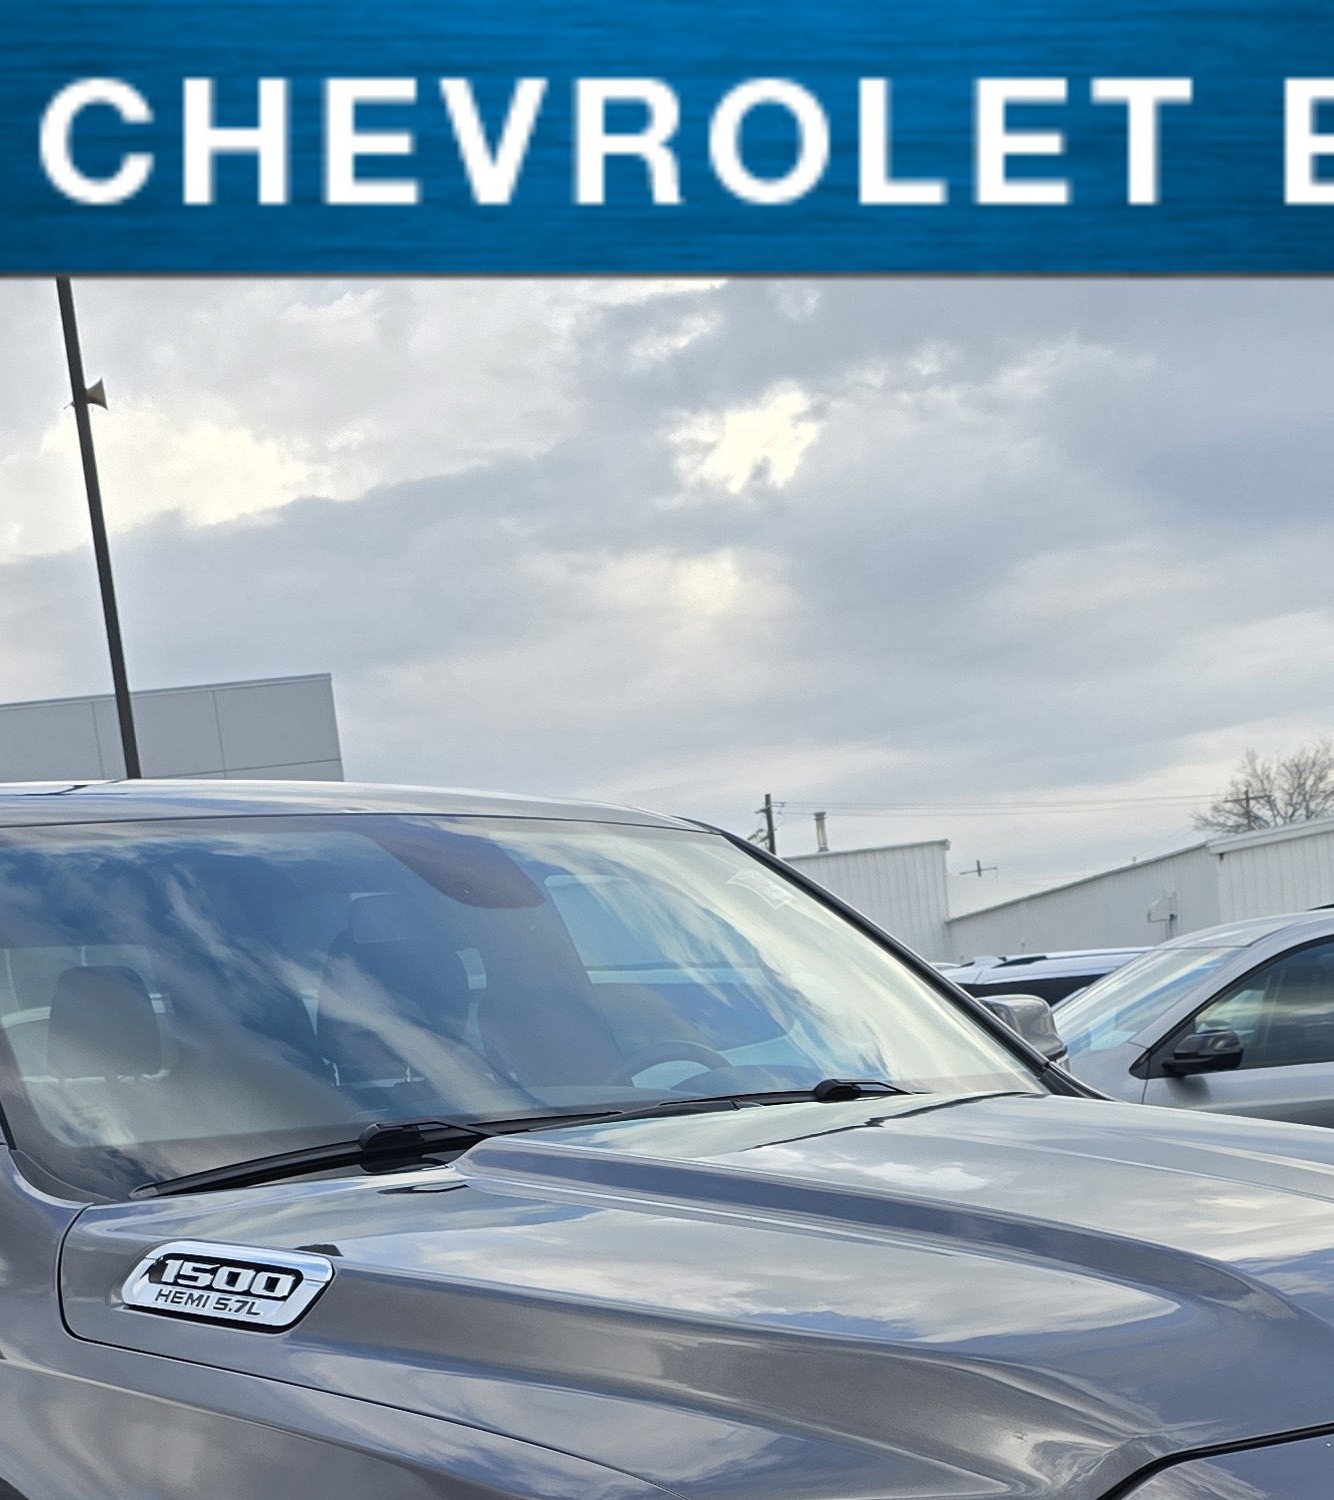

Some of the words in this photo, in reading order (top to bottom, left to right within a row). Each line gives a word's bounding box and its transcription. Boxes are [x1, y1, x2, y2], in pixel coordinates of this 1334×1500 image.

[160, 1258, 296, 1298] 1500
[154, 1288, 211, 1309] HEMI
[212, 1296, 262, 1316] 5.7L
